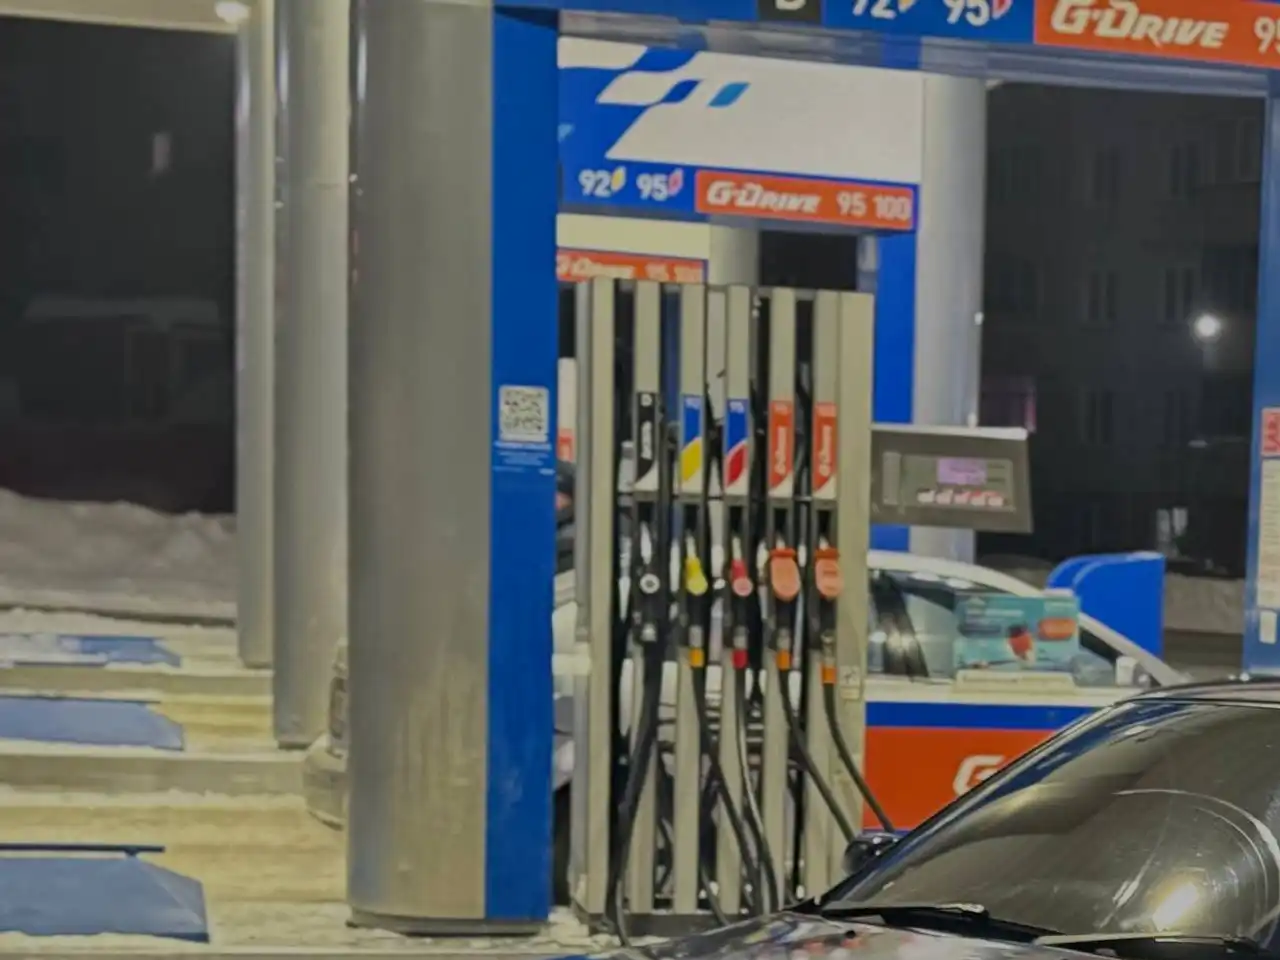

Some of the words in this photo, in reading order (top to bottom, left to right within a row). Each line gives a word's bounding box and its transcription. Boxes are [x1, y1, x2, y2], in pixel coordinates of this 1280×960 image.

[579, 170, 612, 197] 92
[636, 174, 669, 201] 95
[836, 191, 866, 216] 95
[874, 196, 912, 221] 100
